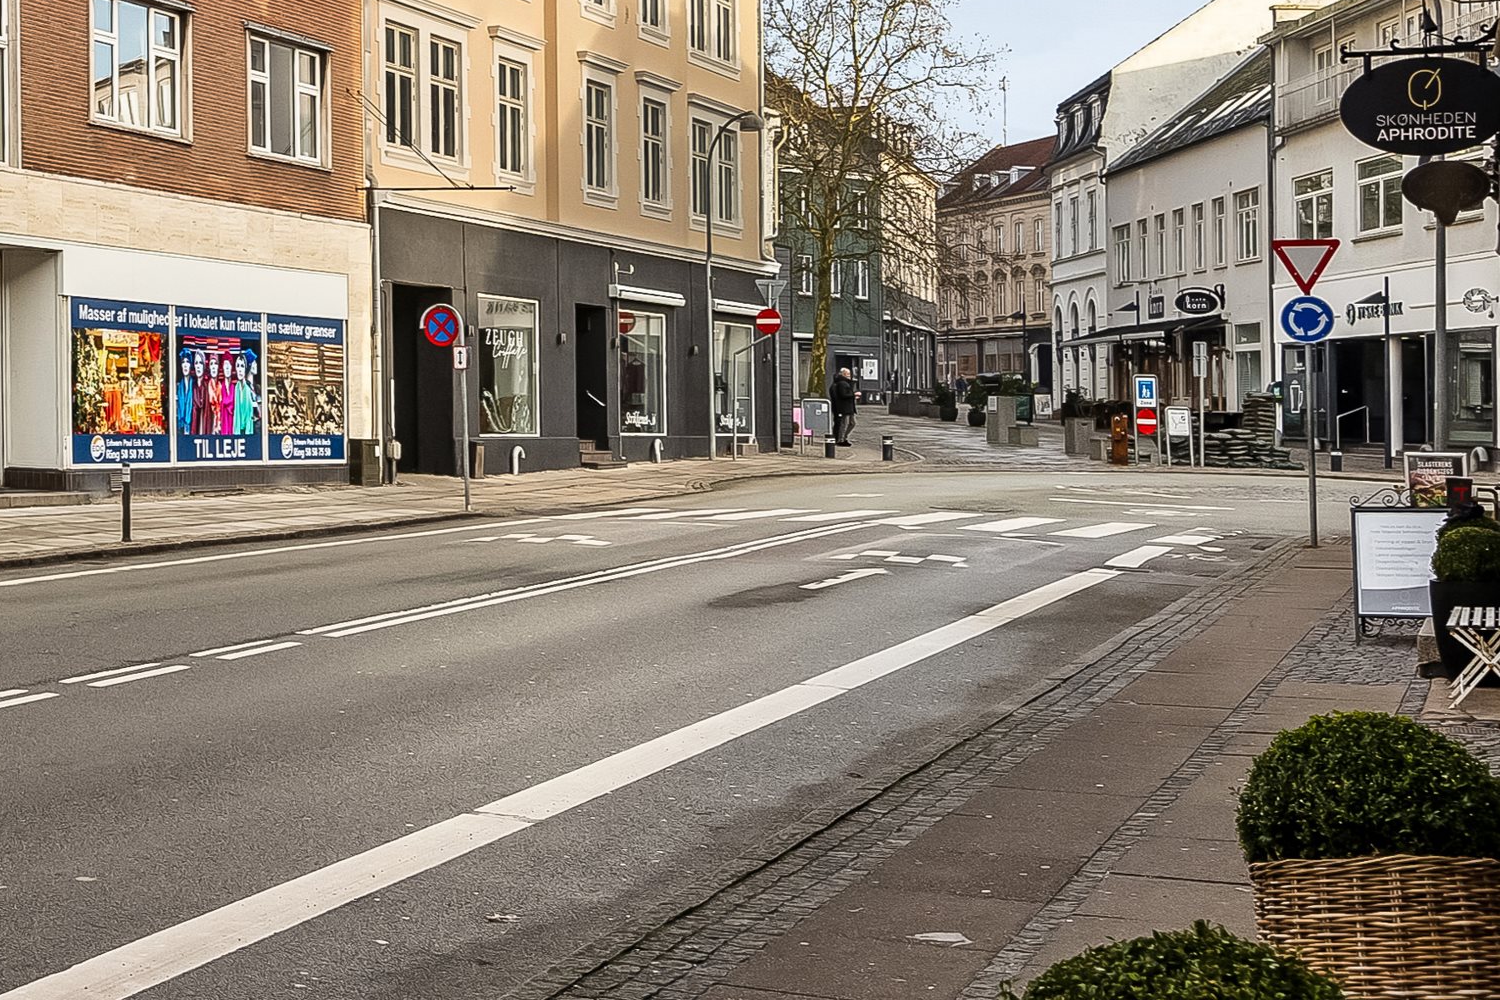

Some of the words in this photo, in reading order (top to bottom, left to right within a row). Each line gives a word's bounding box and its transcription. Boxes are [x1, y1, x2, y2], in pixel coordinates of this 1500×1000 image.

[1375, 111, 1476, 127] SKØNHEDEN
[1376, 125, 1476, 142] APHRODITE
[1186, 301, 1208, 310] korn
[78, 304, 116, 322] Masser
[116, 307, 128, 322] af
[183, 313, 188, 328] i
[189, 313, 219, 331] lokalet
[219, 316, 236, 330] kun
[278, 321, 305, 336] sætter
[305, 324, 337, 339] grænser
[105, 448, 120, 462] Ring
[193, 438, 214, 458] TIL
[215, 438, 246, 458] LEJE
